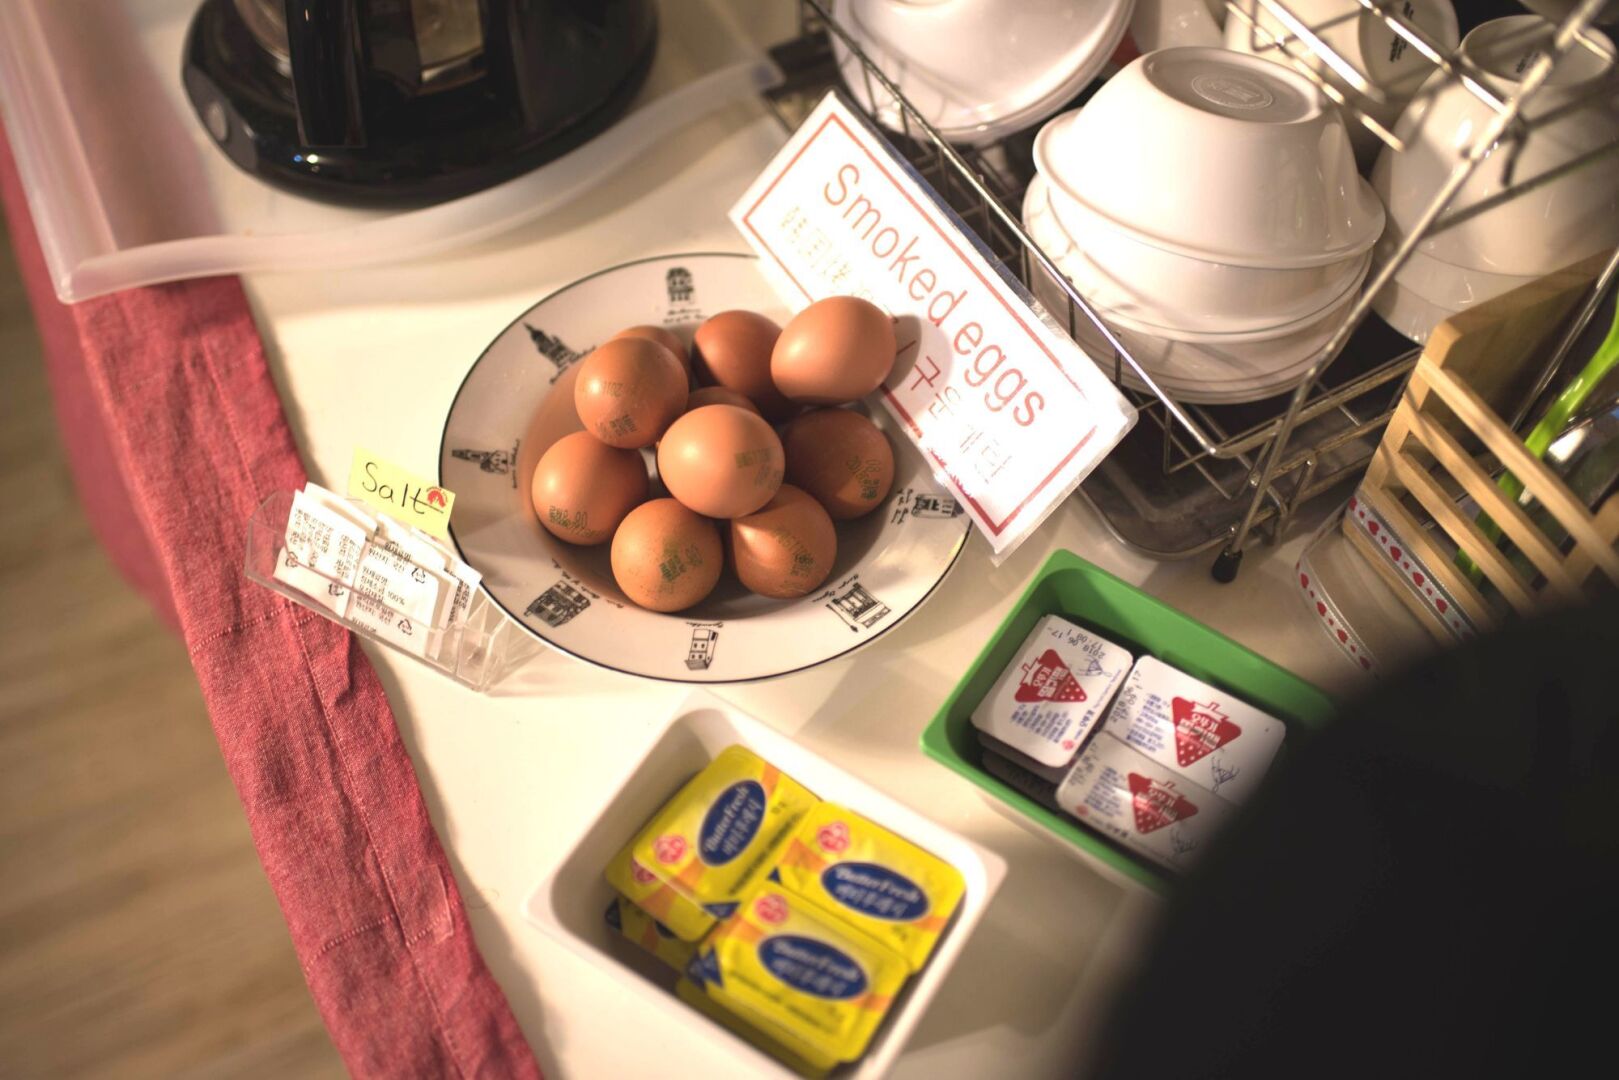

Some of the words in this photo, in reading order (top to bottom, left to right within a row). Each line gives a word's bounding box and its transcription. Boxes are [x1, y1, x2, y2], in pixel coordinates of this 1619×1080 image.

[823, 163, 969, 327] Smoked
[952, 321, 1045, 427] eggs
[362, 461, 444, 515] Salt
